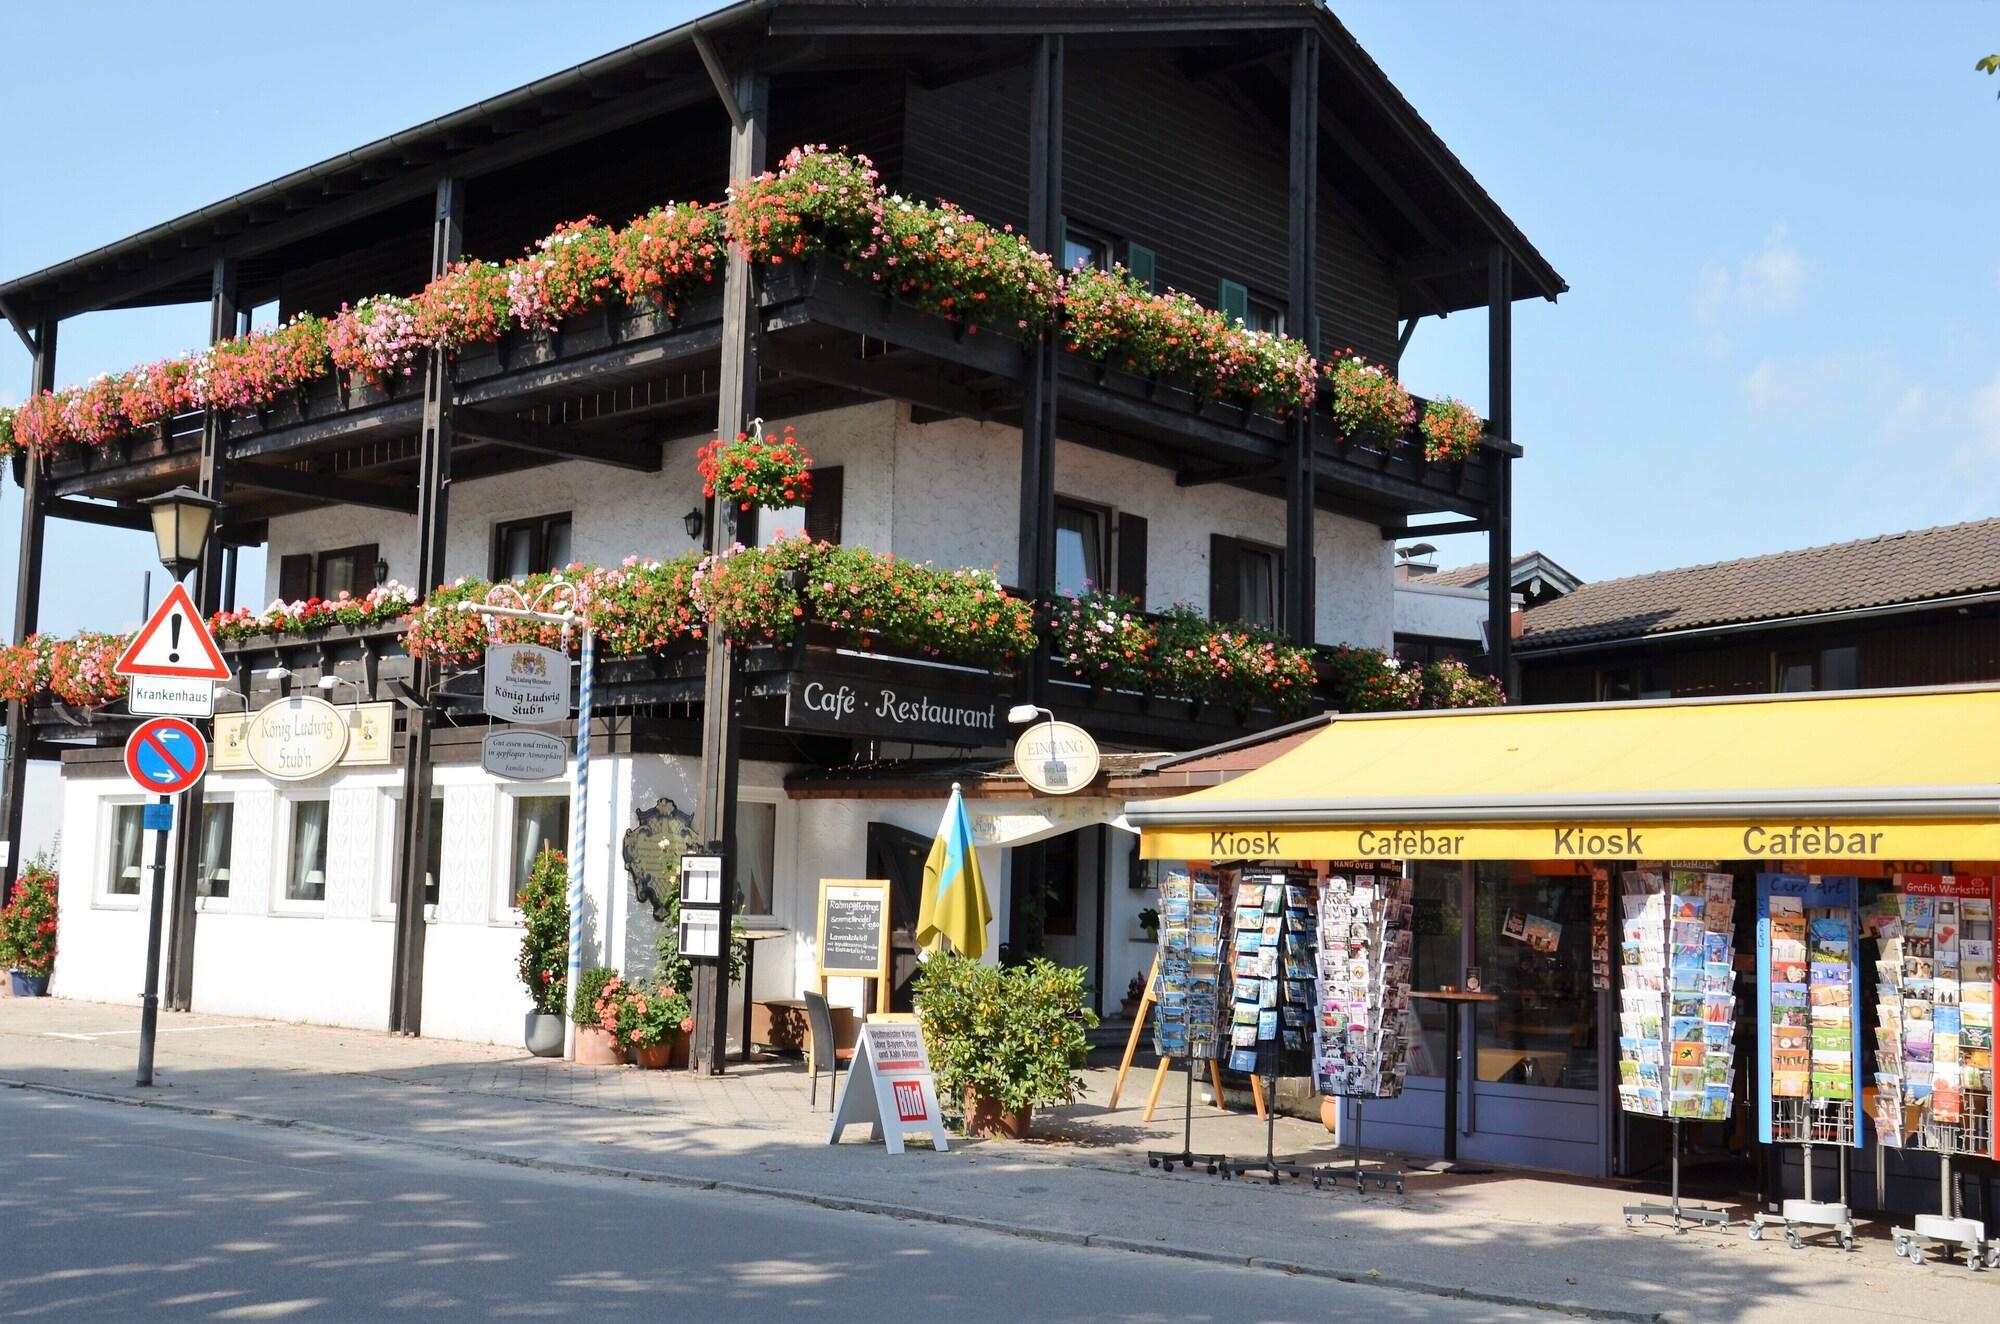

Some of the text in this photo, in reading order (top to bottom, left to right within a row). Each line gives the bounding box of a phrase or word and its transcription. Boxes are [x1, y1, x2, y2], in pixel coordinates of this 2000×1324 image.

[136, 688, 208, 702] Krankenhaus
[495, 686, 560, 705] König Ludwig
[512, 703, 544, 715] Stub'n
[804, 682, 995, 729] Café Restaurant
[261, 712, 334, 742] König Ludwig
[536, 742, 558, 750] trinken
[1027, 739, 1084, 755] EINGANG
[278, 747, 313, 769] Stub'n
[496, 750, 526, 760] gepflegter
[1211, 826, 1884, 856] Kiosk Cafèbar Kiosk Cafèbar
[1334, 860, 1354, 868] HANG
[1906, 882, 1989, 895] Grafik Werkstatt
[878, 1050, 889, 1058] und
[895, 1085, 925, 1117] Bild
